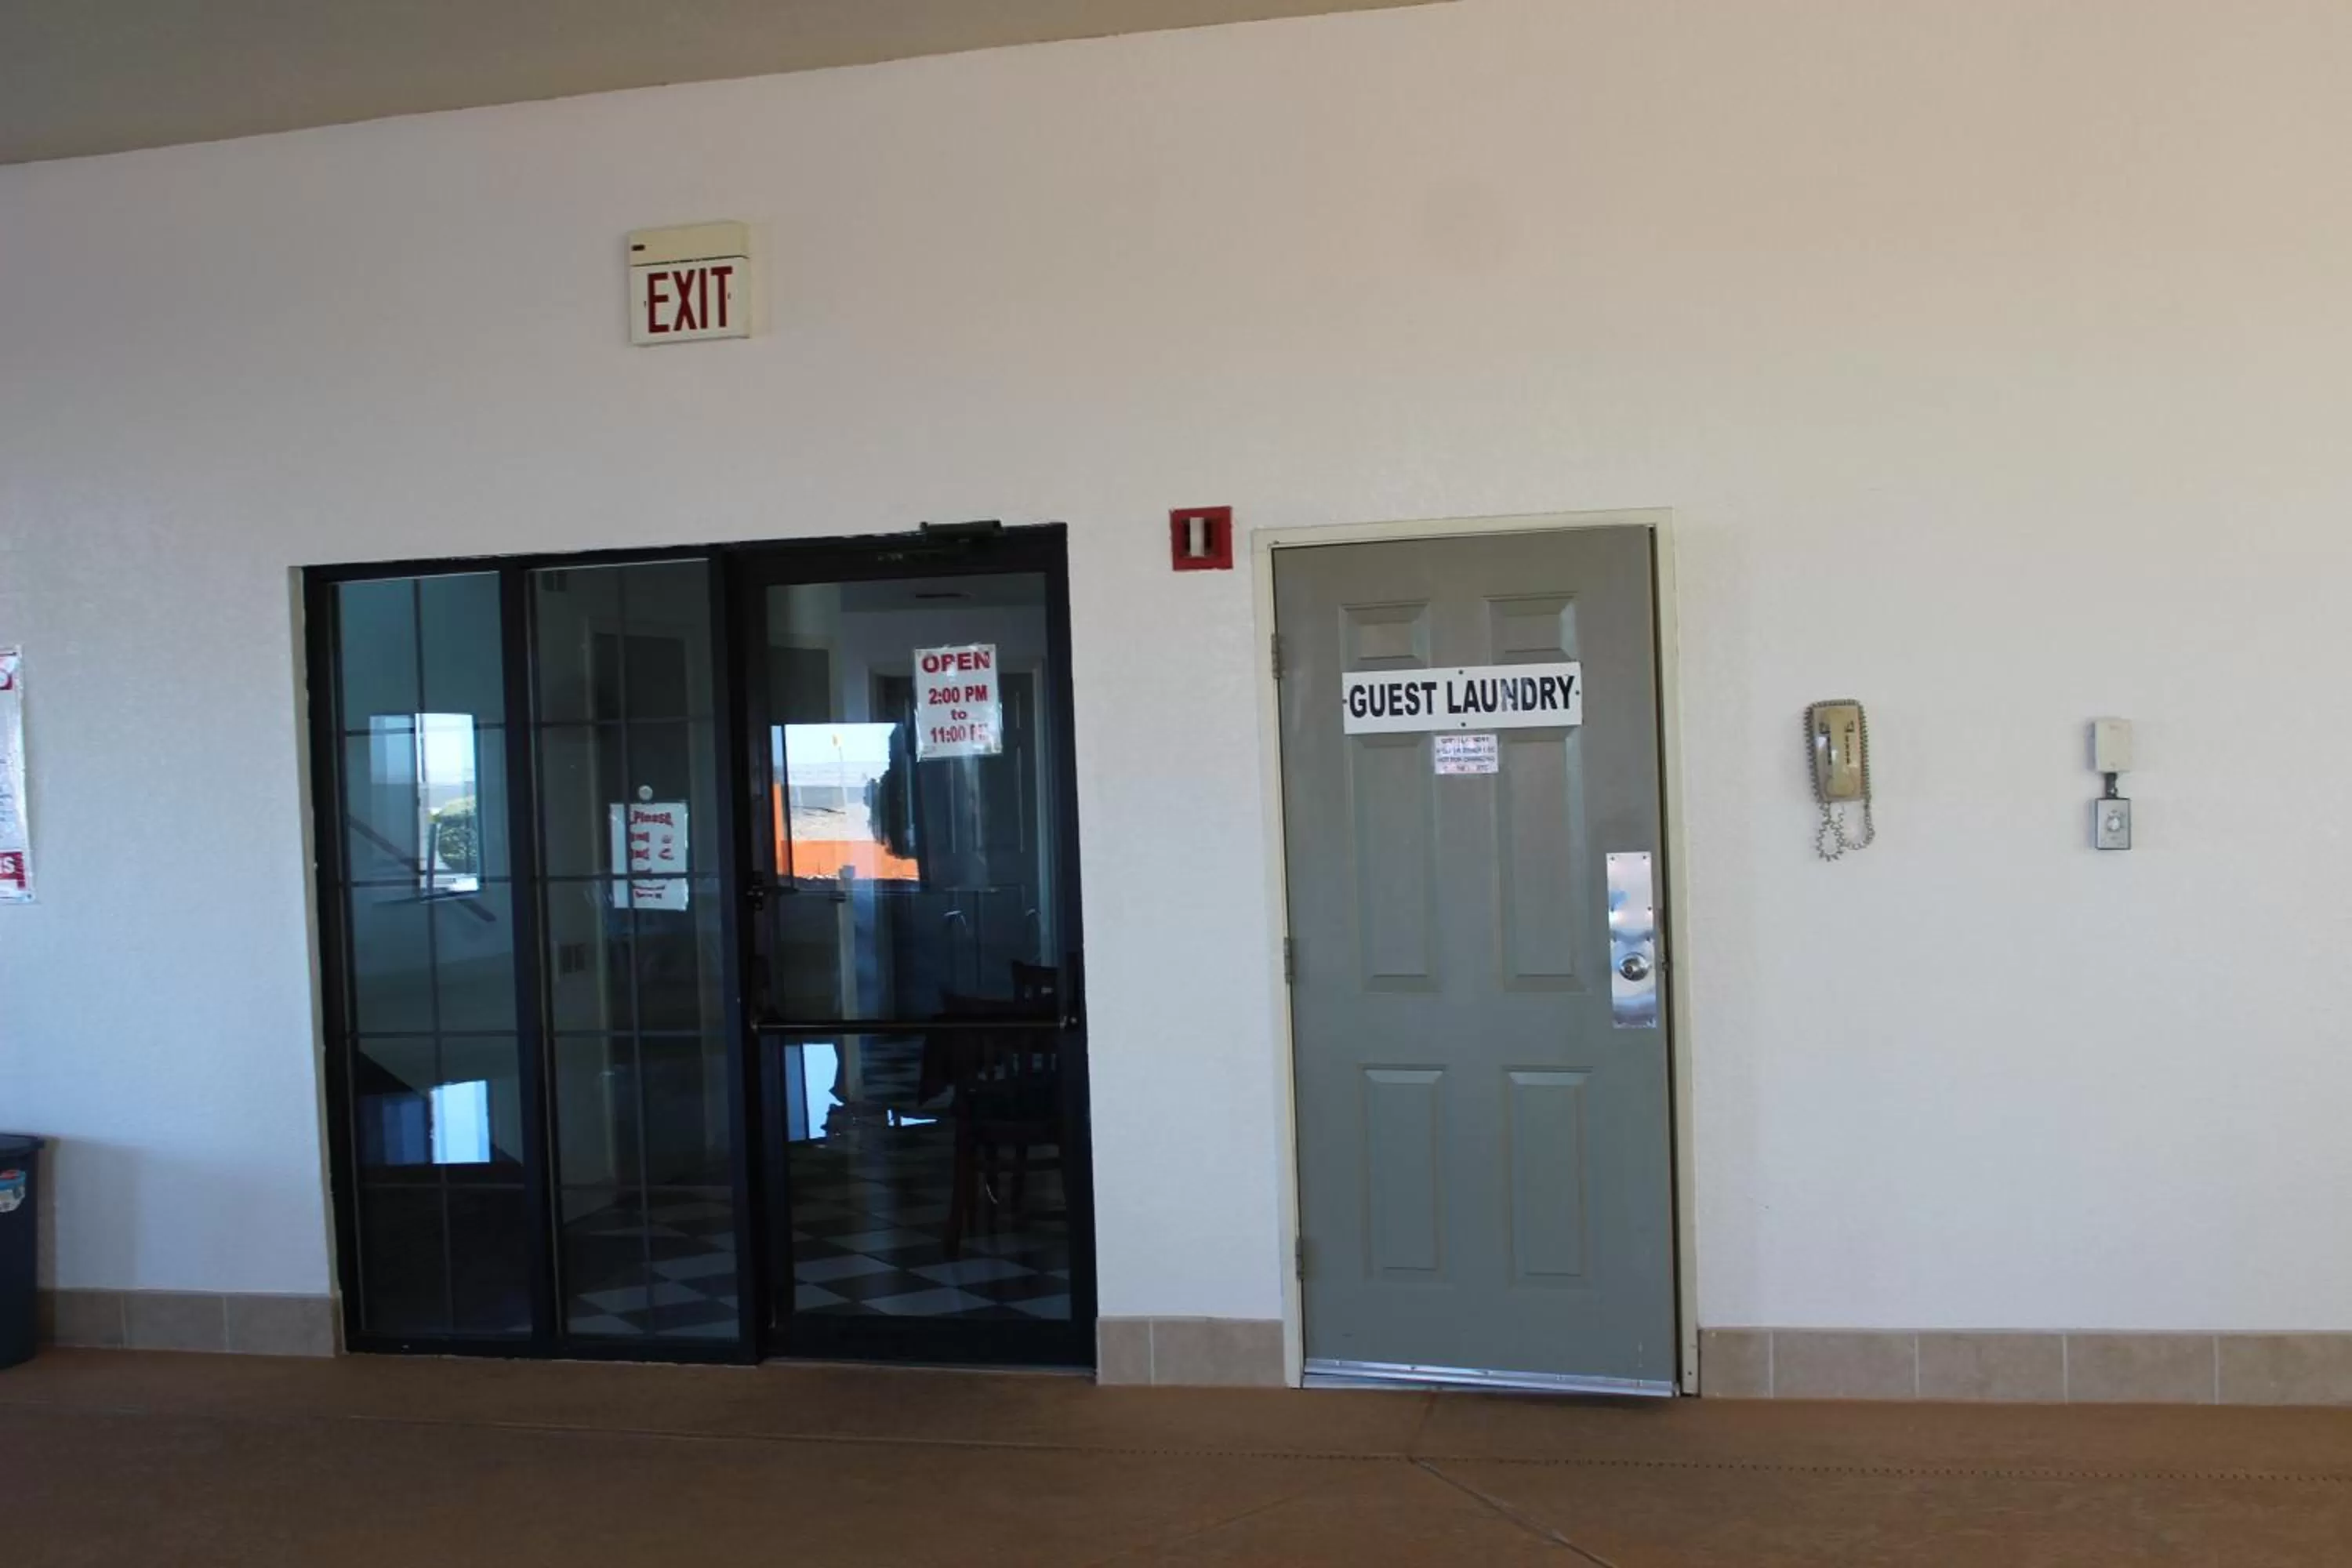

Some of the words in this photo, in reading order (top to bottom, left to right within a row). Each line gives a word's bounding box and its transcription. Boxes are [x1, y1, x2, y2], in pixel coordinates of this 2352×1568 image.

[648, 266, 732, 333] EXIT
[922, 651, 990, 673] OPEN
[928, 687, 960, 704] 2:00
[965, 684, 988, 702] PM
[1349, 681, 1437, 718] GUEST
[1446, 675, 1575, 714] LAUNDRY
[951, 709, 967, 720] to
[931, 724, 965, 743] 11:00
